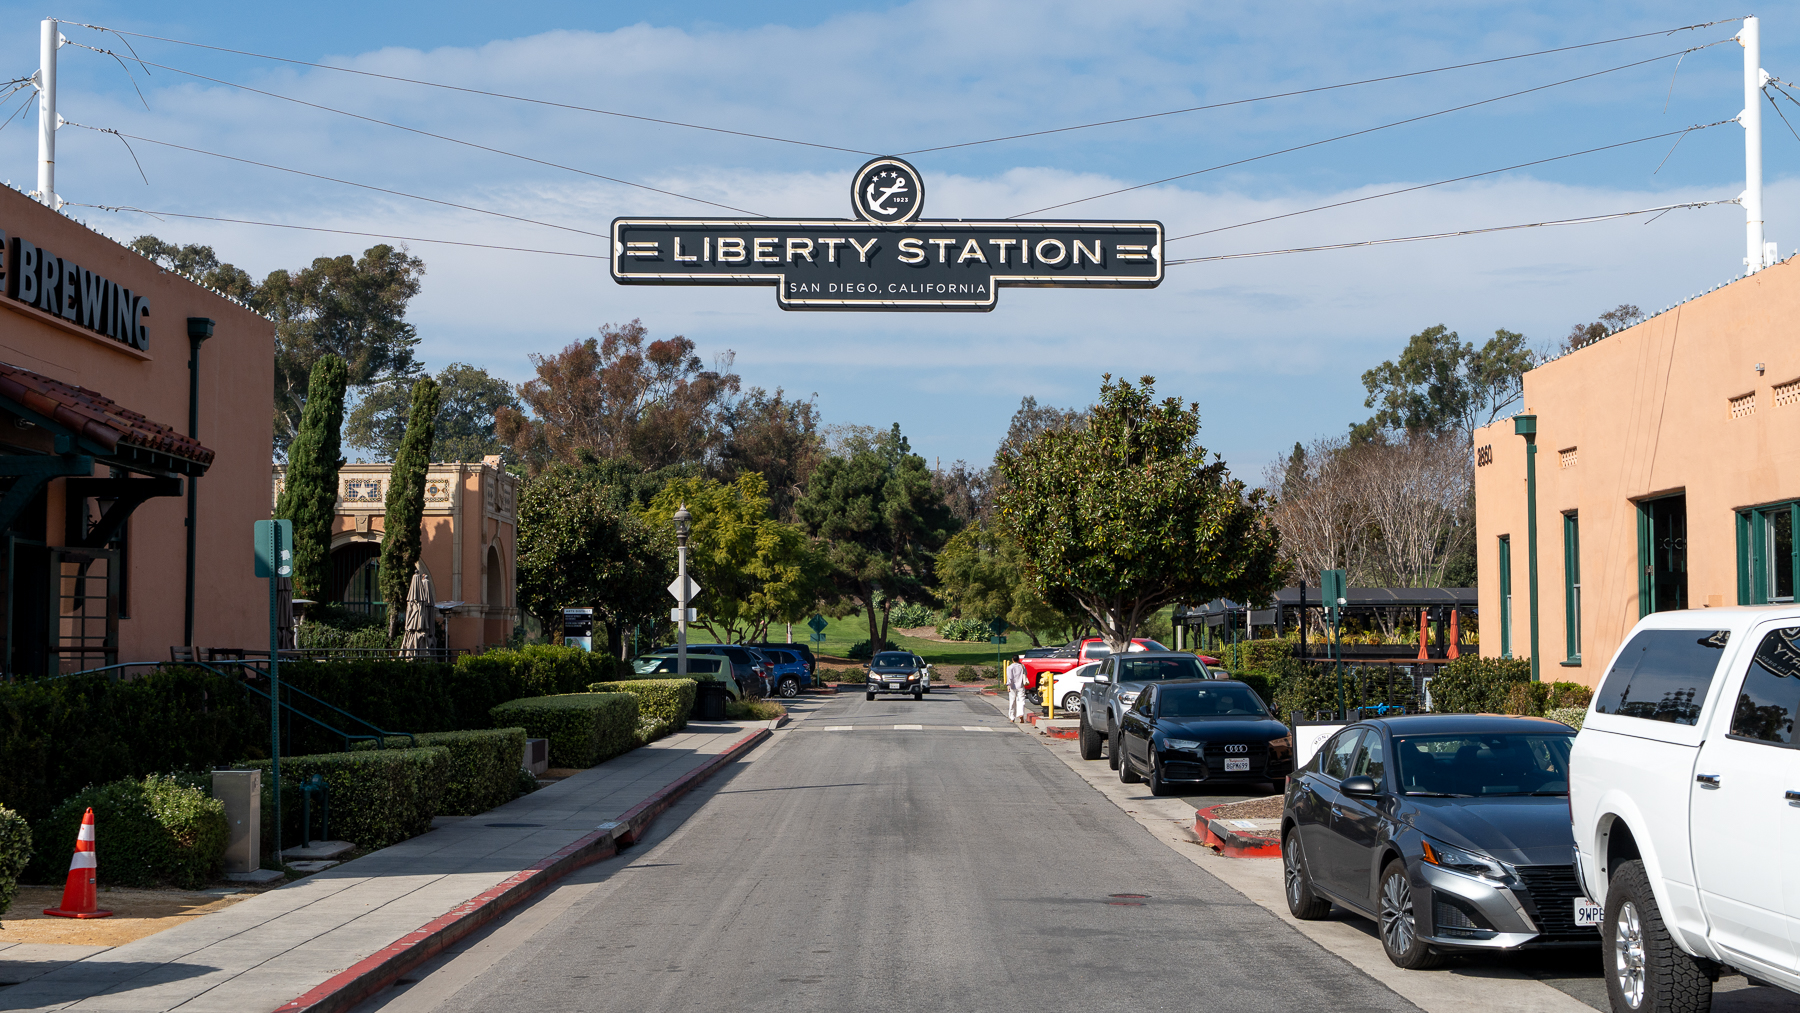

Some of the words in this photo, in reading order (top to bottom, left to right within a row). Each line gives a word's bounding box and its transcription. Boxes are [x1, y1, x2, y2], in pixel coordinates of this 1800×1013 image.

[673, 236, 878, 263] LIBERTY
[897, 237, 1101, 264] STATION
[13, 237, 150, 351] BREWING
[790, 283, 820, 293] SAN
[829, 283, 882, 294] DIEGO,
[888, 283, 986, 293] CALIFORNIA
[1477, 444, 1493, 467] 2860
[1579, 907, 1605, 922] 9WPE
